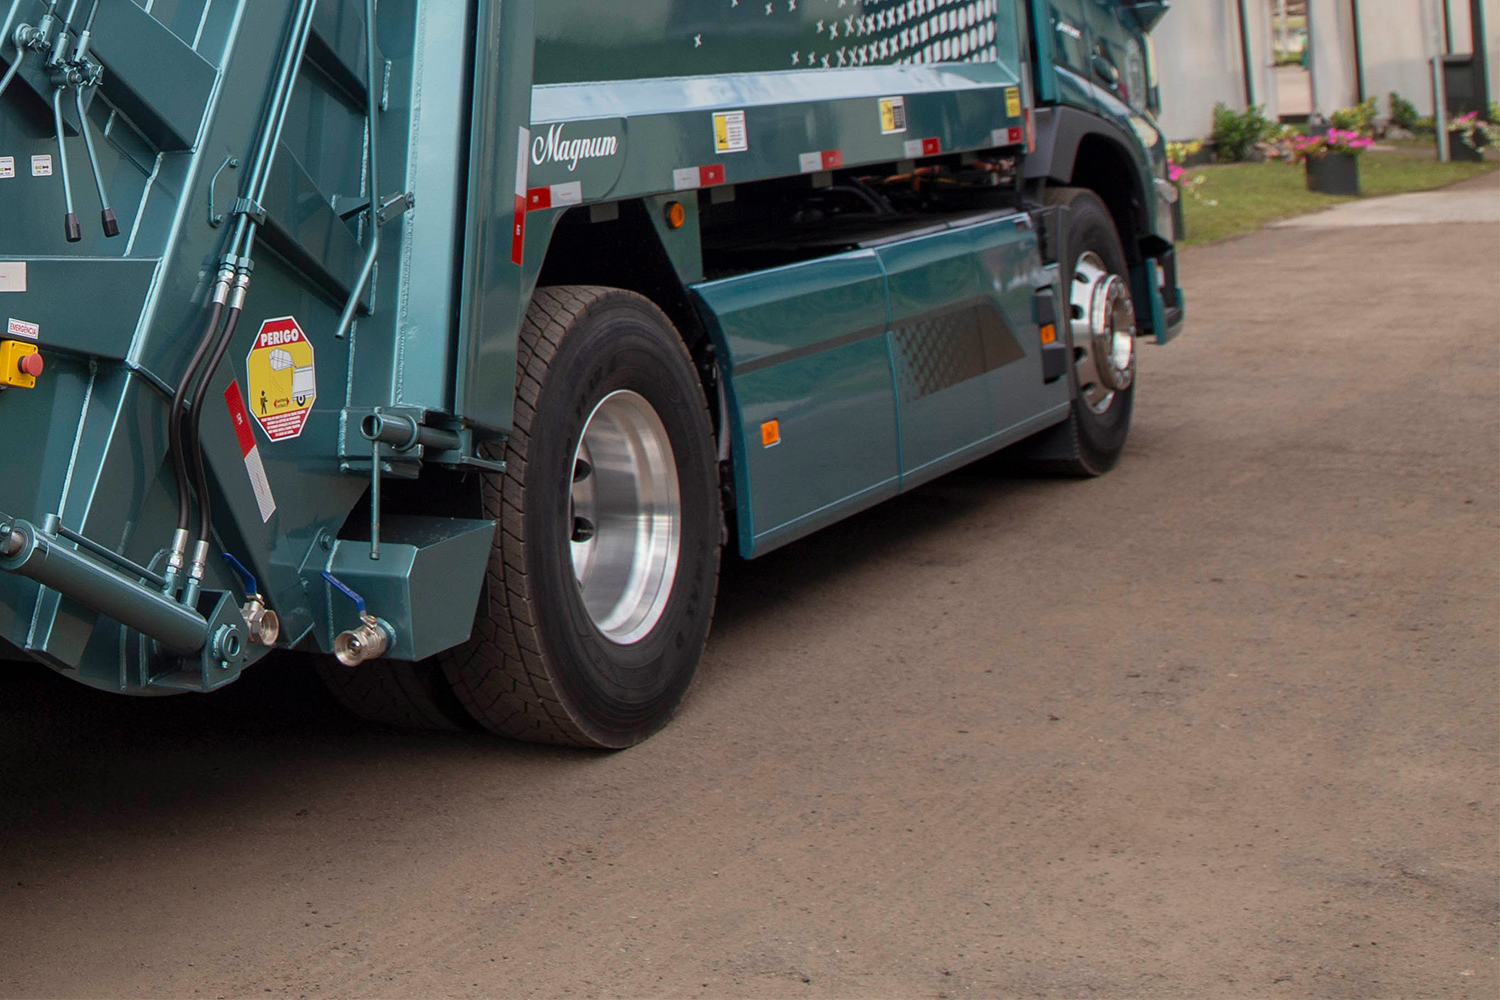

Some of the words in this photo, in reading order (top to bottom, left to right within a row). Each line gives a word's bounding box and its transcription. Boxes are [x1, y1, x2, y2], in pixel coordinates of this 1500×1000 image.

[532, 123, 618, 171] Magnum
[10, 322, 37, 335] EMERGÊNCIA
[260, 328, 299, 347] PERIGO
